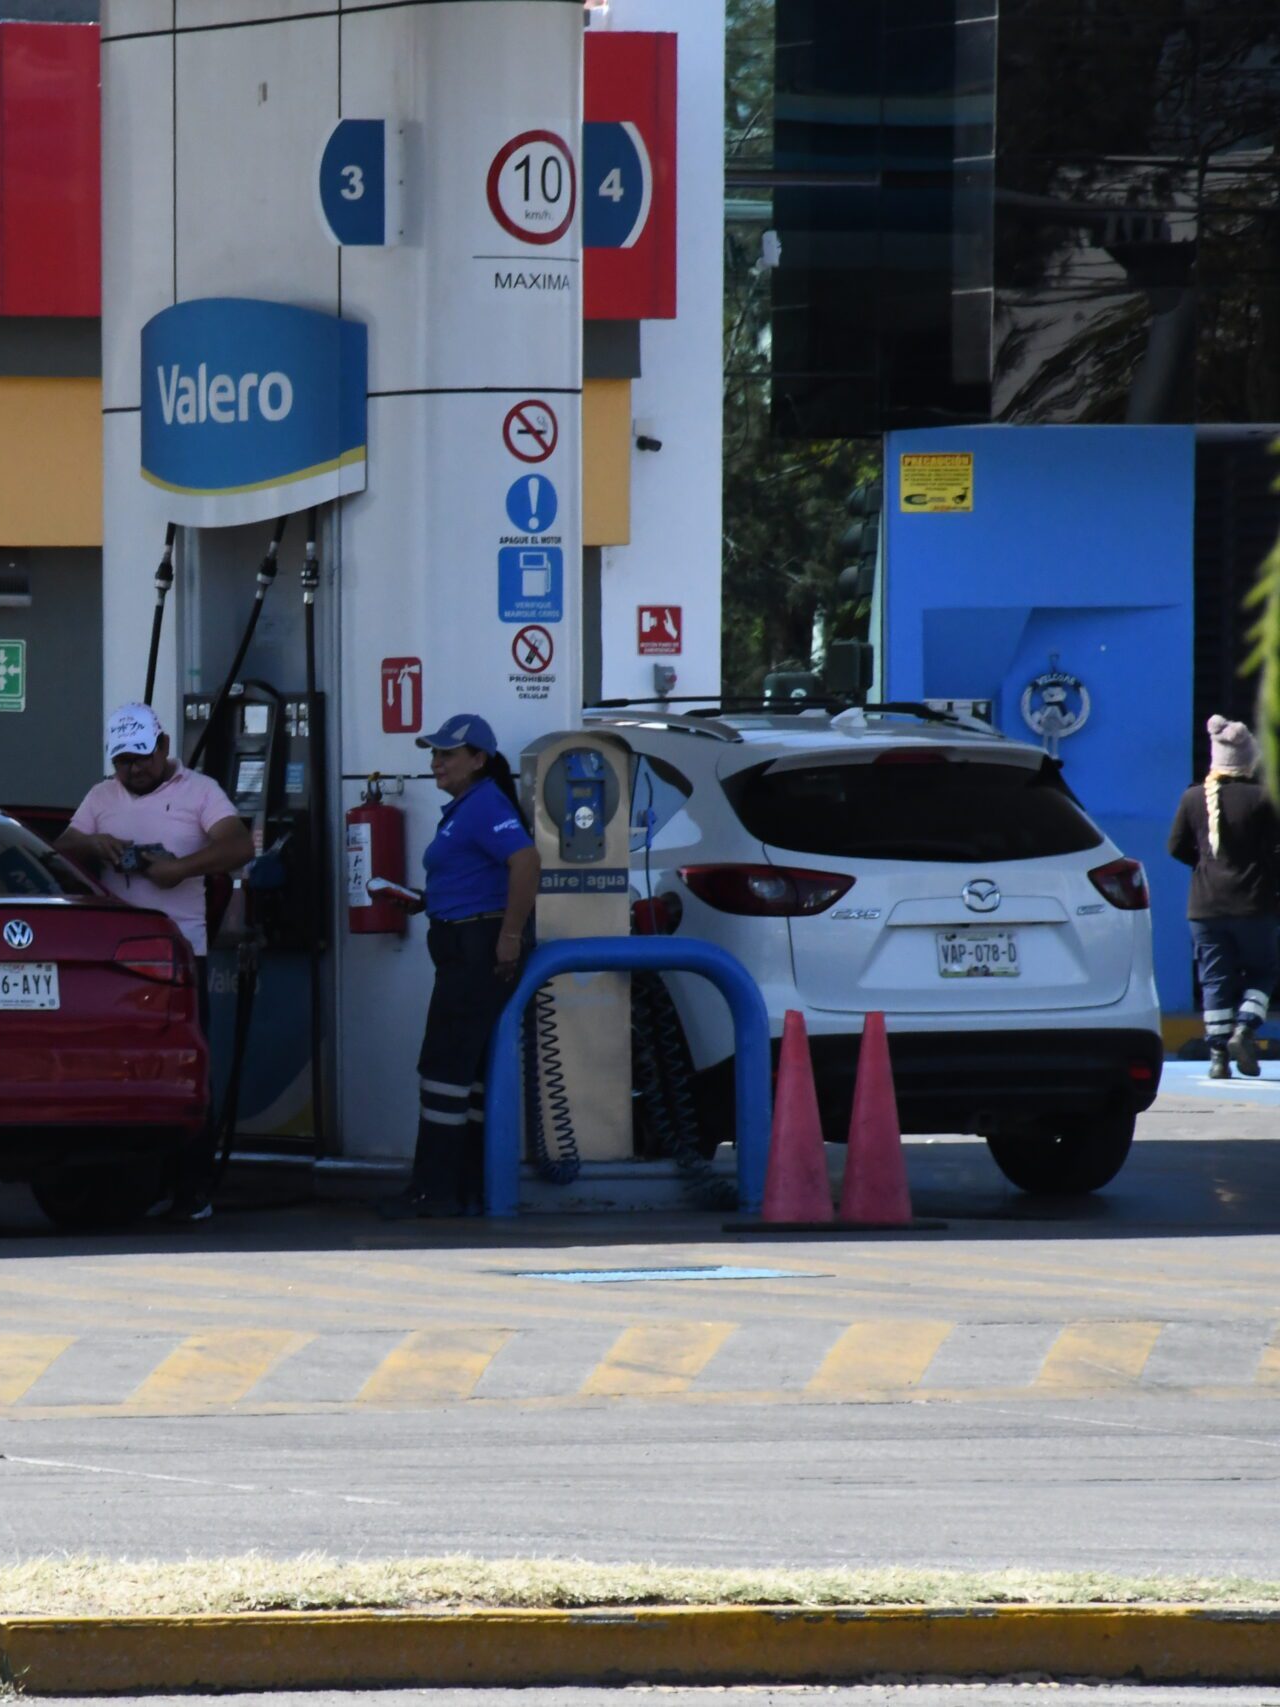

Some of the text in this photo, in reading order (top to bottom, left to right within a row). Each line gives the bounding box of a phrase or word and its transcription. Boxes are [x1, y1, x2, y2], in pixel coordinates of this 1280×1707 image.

[340, 165, 365, 200] 3
[514, 154, 563, 204] 10
[598, 168, 624, 202] 4
[494, 272, 570, 290] MAXIMA
[157, 362, 294, 425] Valero
[499, 536, 529, 544] APAGUE
[531, 536, 539, 544] EL
[509, 675, 556, 683] PROHIBIDO
[541, 873, 579, 887] aire
[586, 874, 625, 889] agua
[941, 943, 1017, 963] VAP-078-D
